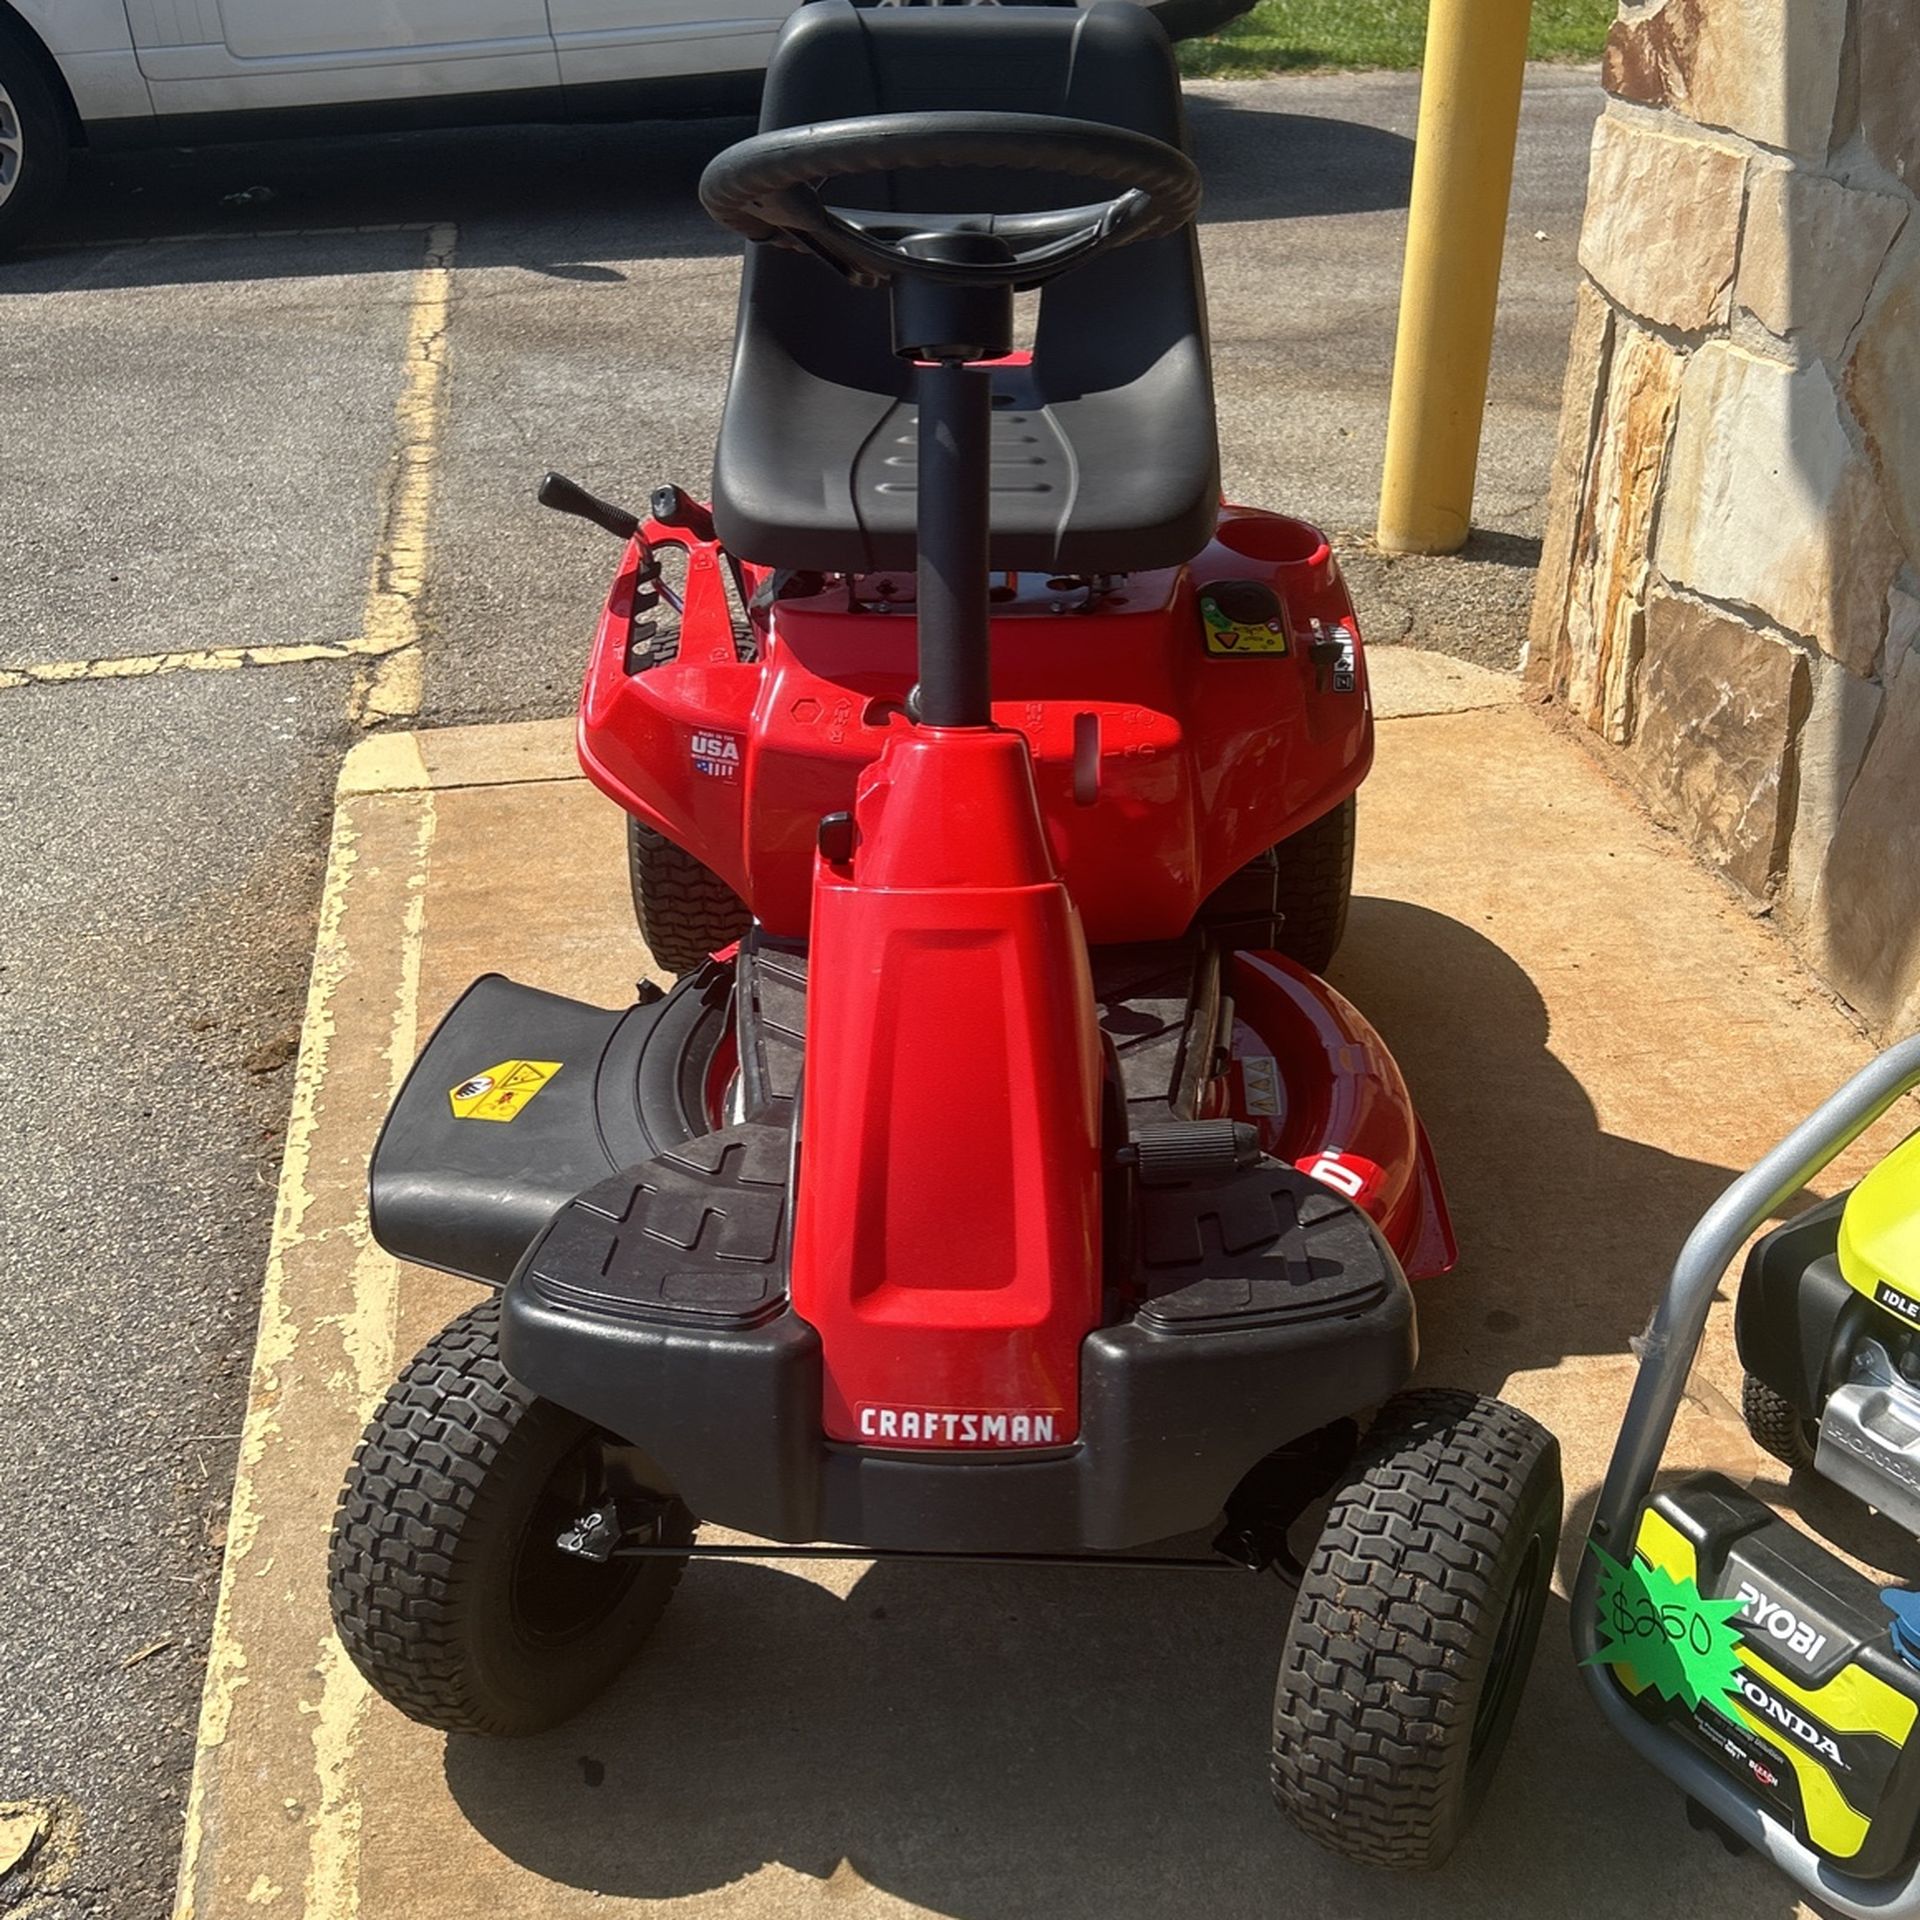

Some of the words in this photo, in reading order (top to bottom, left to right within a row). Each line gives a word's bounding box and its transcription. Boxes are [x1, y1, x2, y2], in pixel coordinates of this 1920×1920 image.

[691, 735, 740, 760] USA
[1882, 1288, 1920, 1318] IDLE
[860, 1408, 1055, 1442] CRAFTSMAN
[1612, 1582, 1712, 1656] $250
[1735, 1581, 1827, 1662] RYOBI
